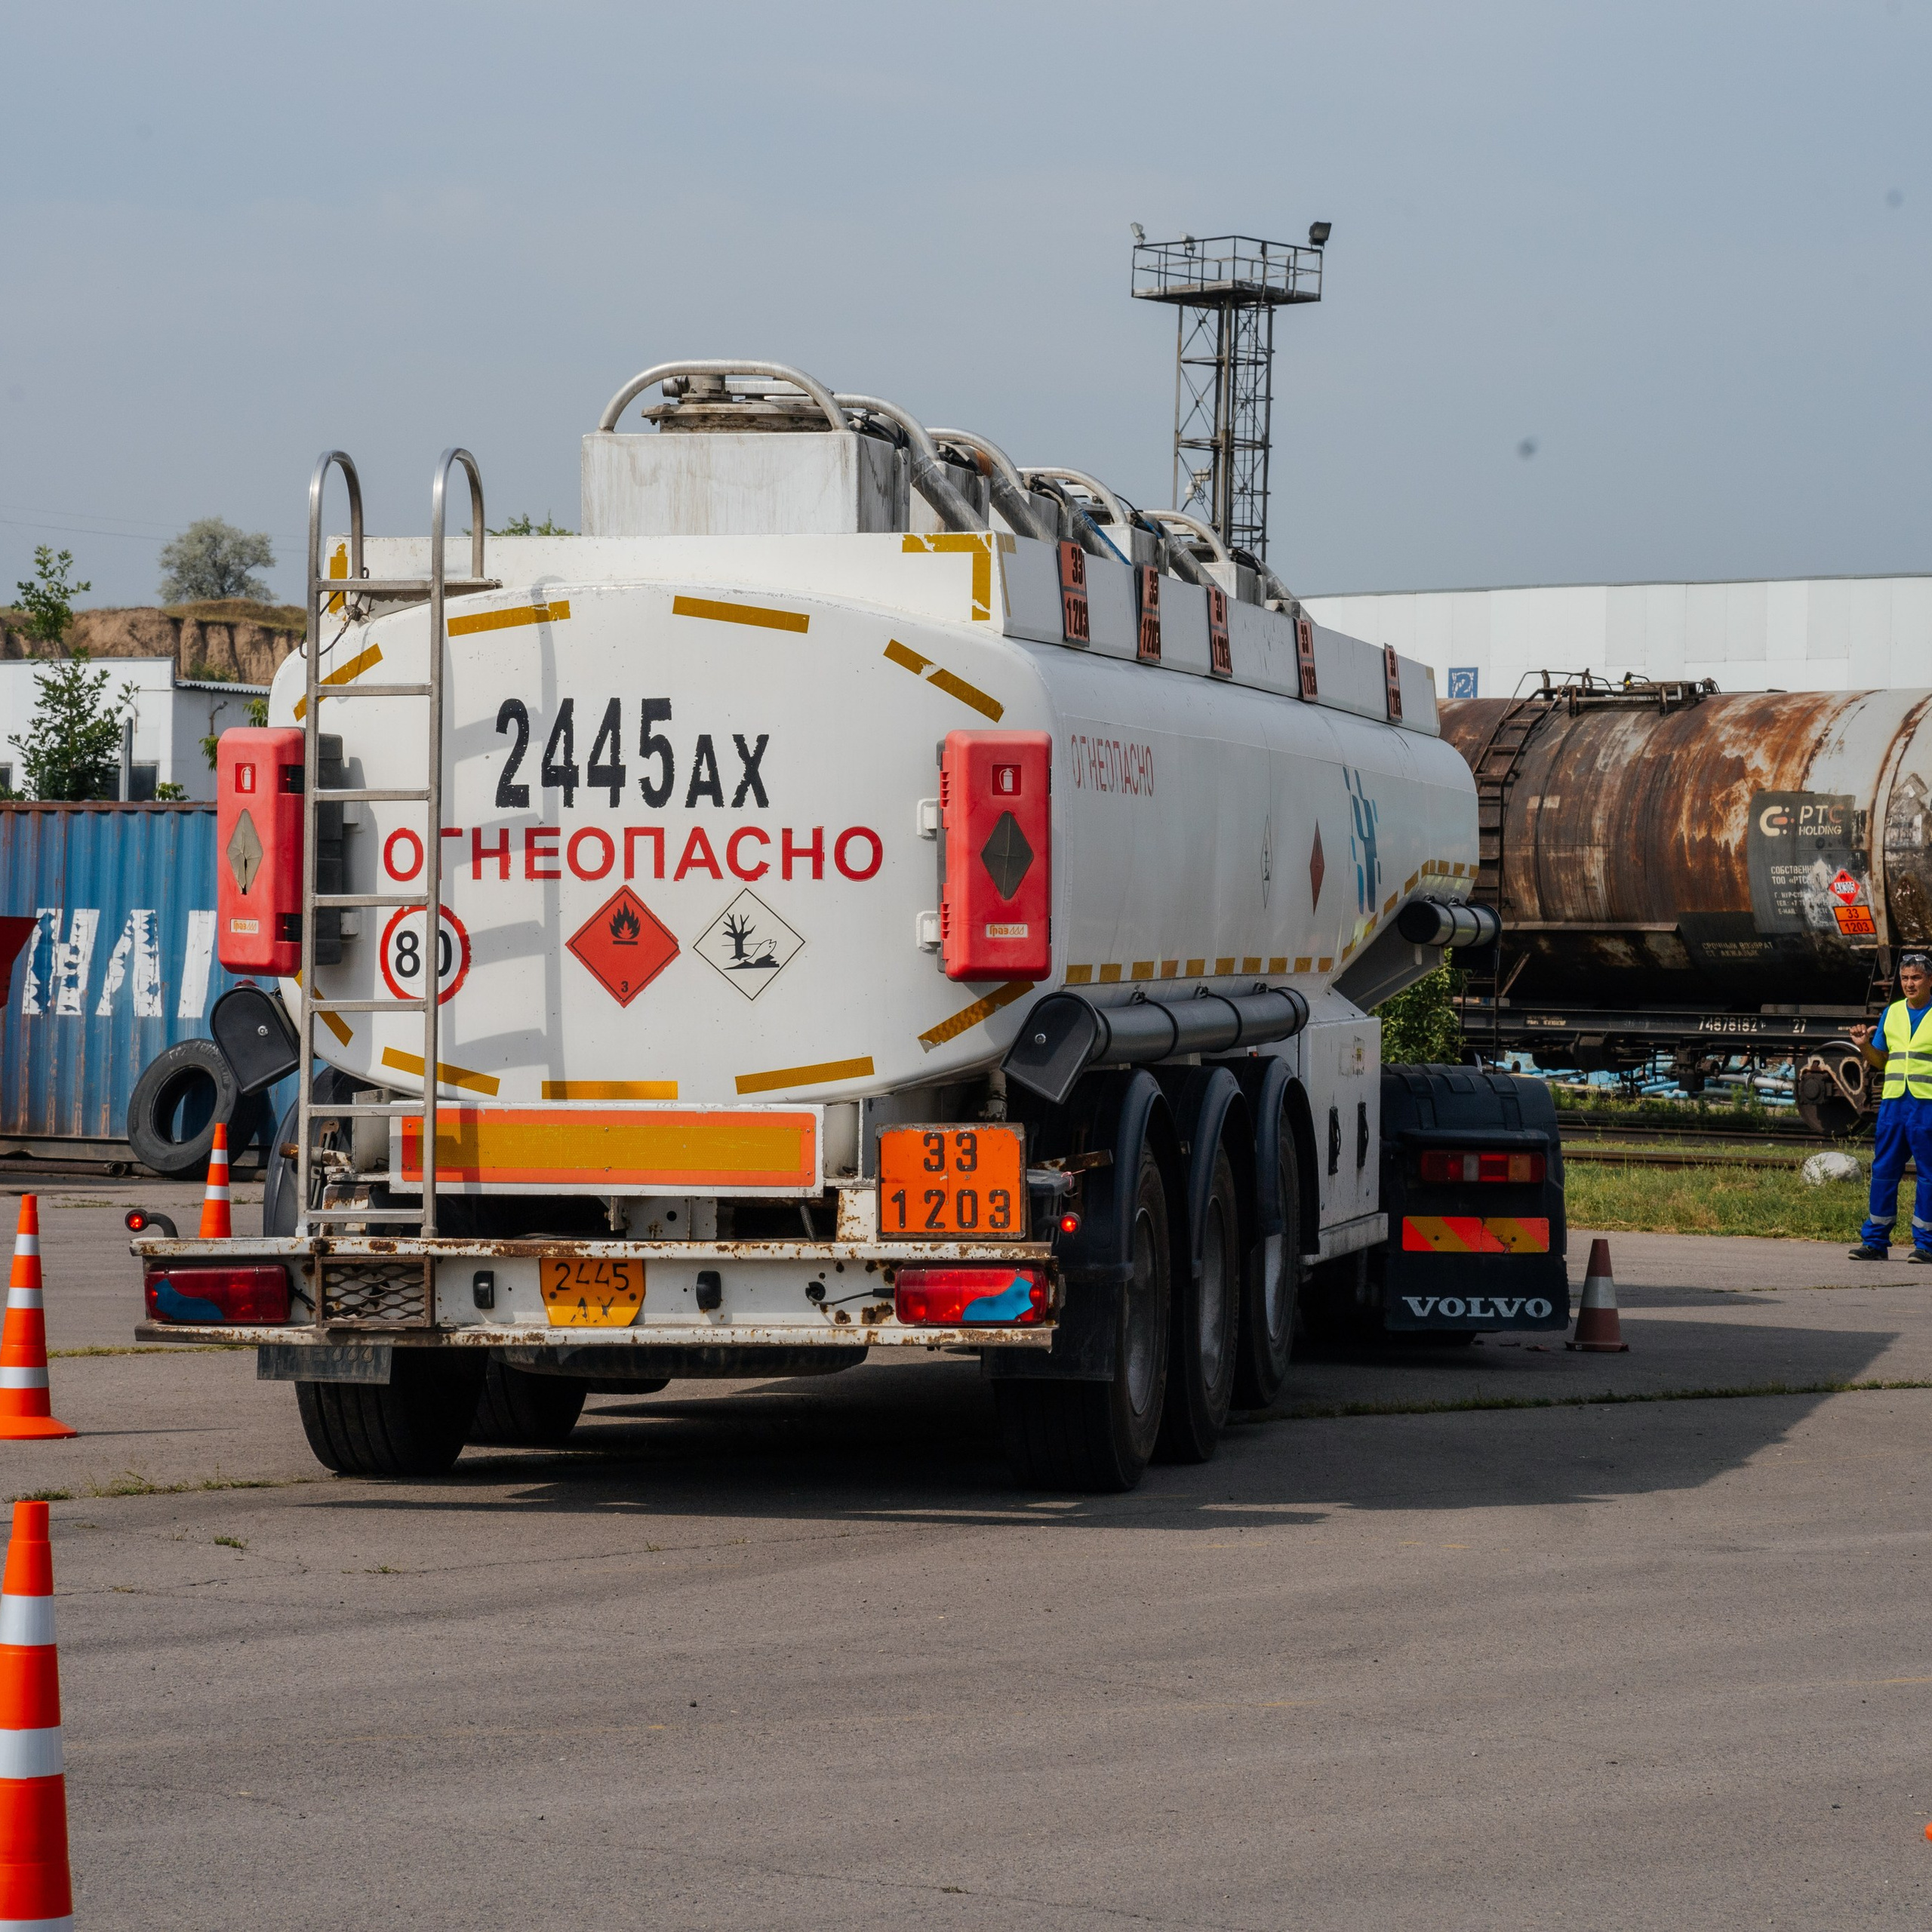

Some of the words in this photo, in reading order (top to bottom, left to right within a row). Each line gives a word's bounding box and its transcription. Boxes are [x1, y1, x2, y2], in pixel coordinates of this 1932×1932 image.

[1071, 546, 1084, 585] 33
[1149, 570, 1158, 605] 33
[1066, 597, 1088, 638] 1203
[1072, 734, 1154, 797] ОГНЕОПАСНО
[1798, 826, 1842, 835] HOLDING
[1845, 922, 1869, 933] 1203
[1847, 909, 1860, 918] 33
[620, 981, 628, 992] 3
[923, 1132, 977, 1172] 33
[891, 1189, 1011, 1229] 1203
[555, 1262, 629, 1291] 2445
[1401, 1296, 1552, 1318] VOLVO
